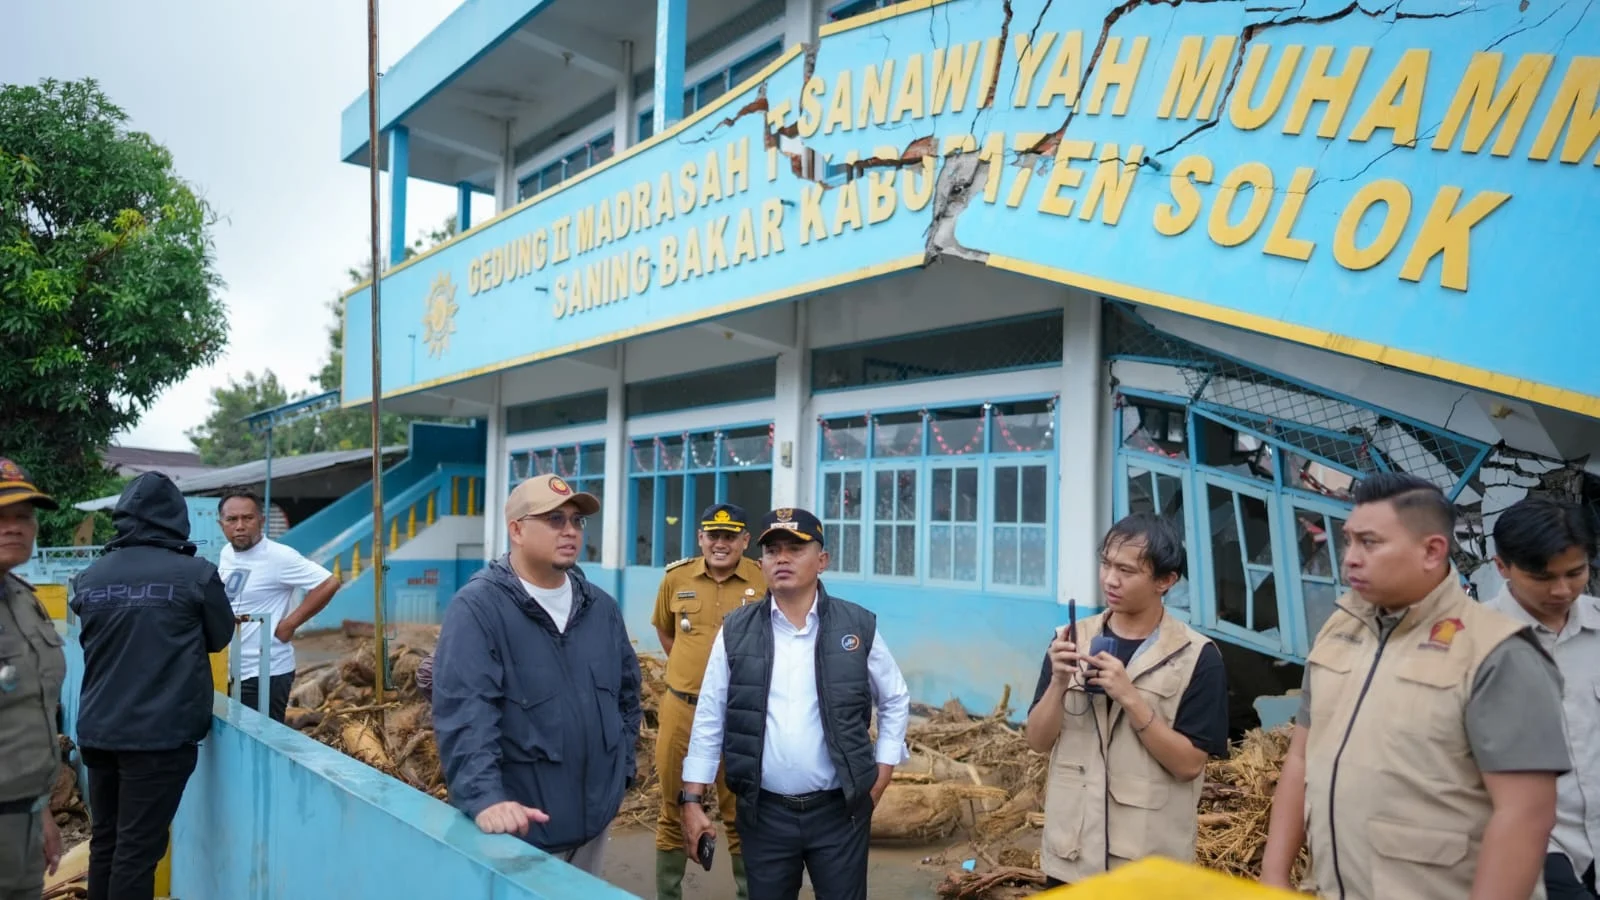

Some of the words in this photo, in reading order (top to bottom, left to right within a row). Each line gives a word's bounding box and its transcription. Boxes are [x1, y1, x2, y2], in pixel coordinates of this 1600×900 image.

[467, 227, 549, 297] GEDUNG
[575, 136, 752, 252] MADRASAH
[551, 248, 652, 321] SANING
[658, 197, 786, 288] BAKAR
[1152, 154, 1513, 292] SOLOK
